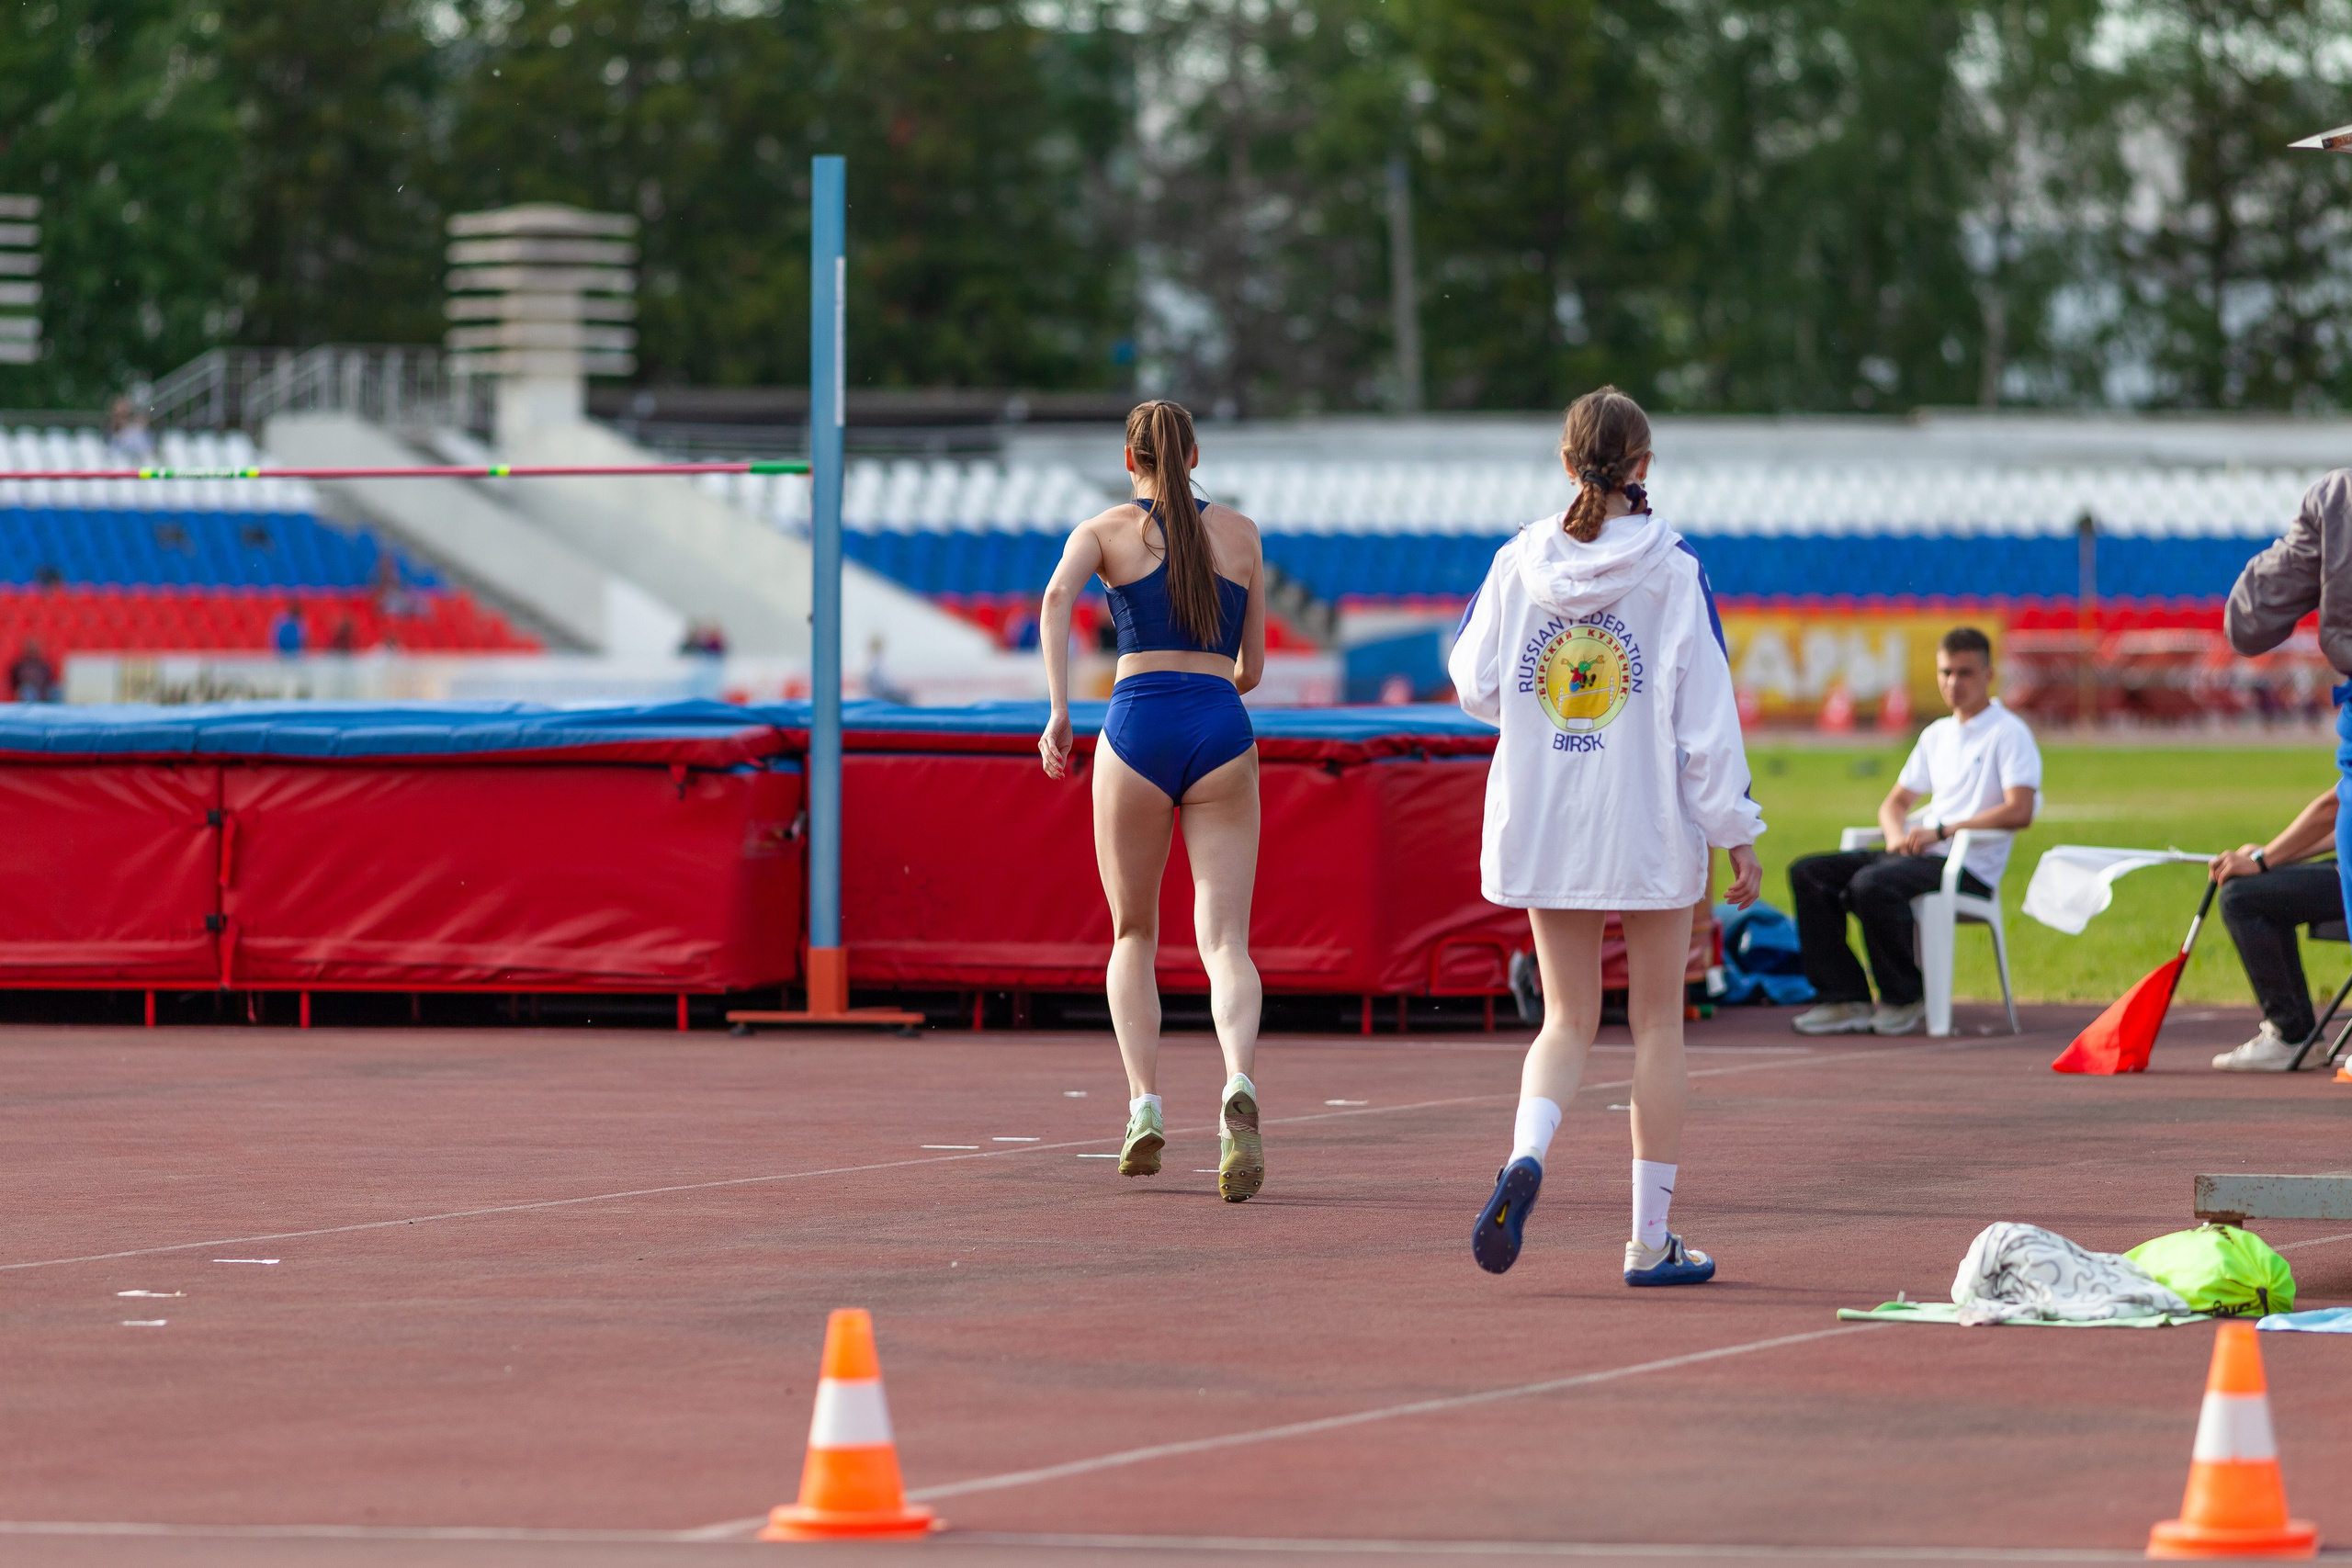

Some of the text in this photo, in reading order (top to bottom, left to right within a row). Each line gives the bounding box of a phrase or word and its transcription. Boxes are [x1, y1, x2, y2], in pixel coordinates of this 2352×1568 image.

[1519, 616, 1565, 694] RUSSIAN
[1537, 629, 1630, 695] БИРСКИЙ КУЗНЕЧИК
[1553, 733, 1604, 752] BIRSK
